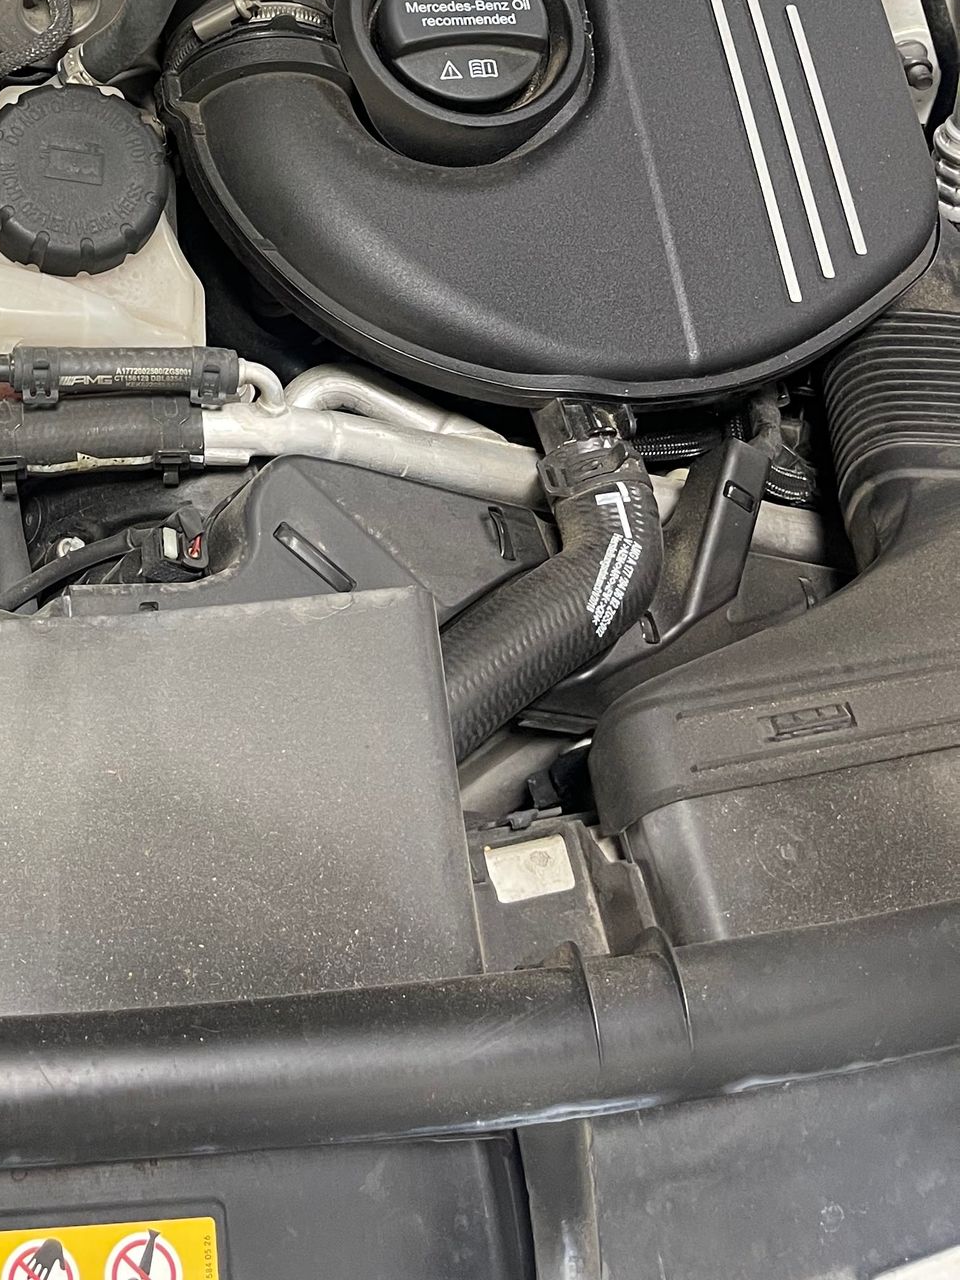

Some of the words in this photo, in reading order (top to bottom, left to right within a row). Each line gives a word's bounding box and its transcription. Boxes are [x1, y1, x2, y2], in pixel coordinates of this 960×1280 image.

[405, 0, 510, 14] Mercedes-Benz
[421, 13, 517, 27] recommended
[203, 1234, 211, 1247] 26
[204, 1248, 212, 1261] 05
